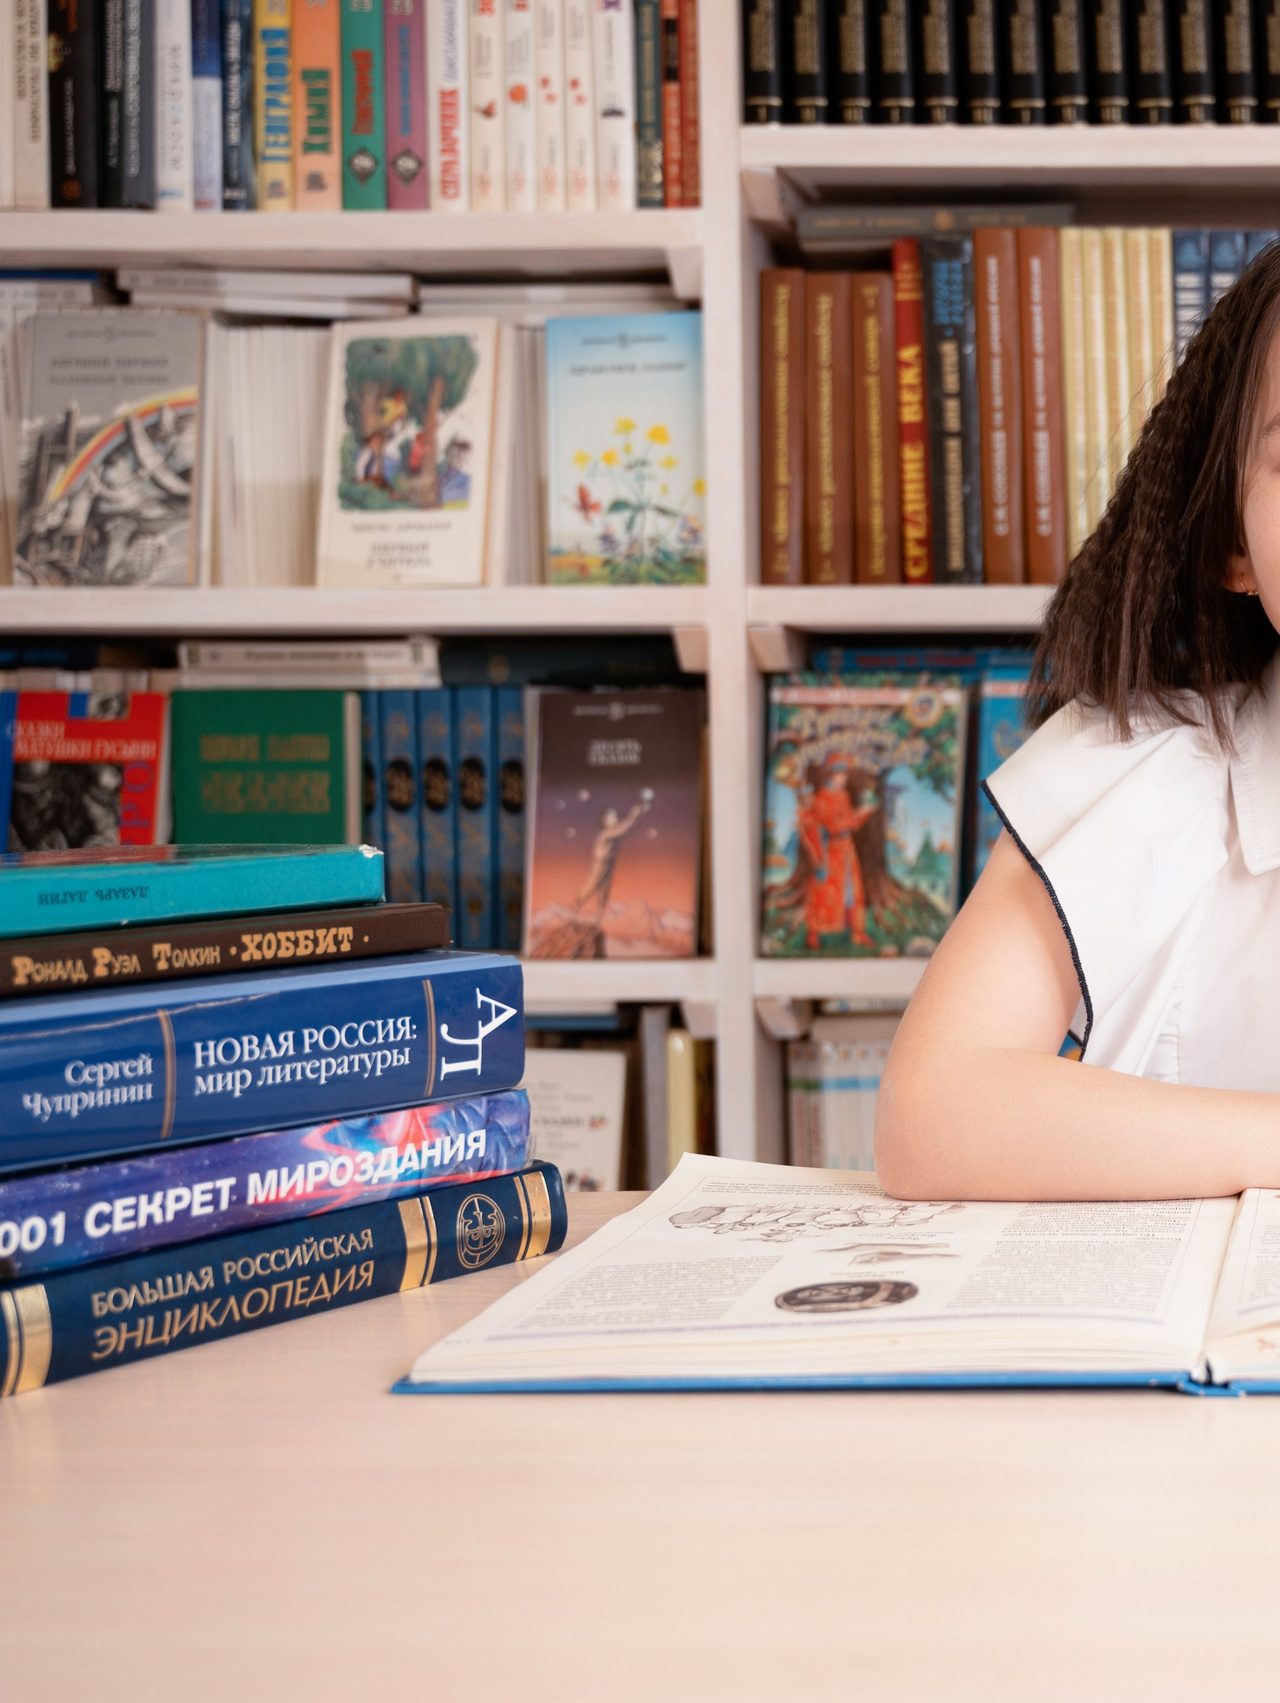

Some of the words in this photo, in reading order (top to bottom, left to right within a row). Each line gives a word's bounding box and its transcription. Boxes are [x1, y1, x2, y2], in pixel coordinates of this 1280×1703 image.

[898, 344, 923, 423] ВЕКА
[902, 440, 928, 578] СРЕДНИЕ
[6, 721, 65, 739] СКАЗКИ
[12, 739, 93, 758] МАТУШКИ
[95, 740, 157, 760] ГУСЫНИ
[38, 889, 88, 906] ЛАГИН
[95, 886, 148, 901] ЛАЗАРЬ
[241, 926, 354, 960] ХОББИТ
[193, 1027, 295, 1068] НОВАЯ
[304, 1015, 417, 1055] РОССИЯ:
[64, 1054, 154, 1086] Сергей
[194, 1066, 252, 1099] мир
[258, 1045, 411, 1085] литературы
[22, 1082, 154, 1122] Чупринин
[84, 1178, 236, 1236] СЕКРЕТ
[247, 1130, 487, 1206] МИРОЗДАНИЯ
[92, 1266, 215, 1319] БОЛЬШАЯ
[223, 1227, 374, 1285] РОССИЙСКАЯ
[92, 1260, 375, 1360] ЭНЦИКЛОПЕДИЯ
